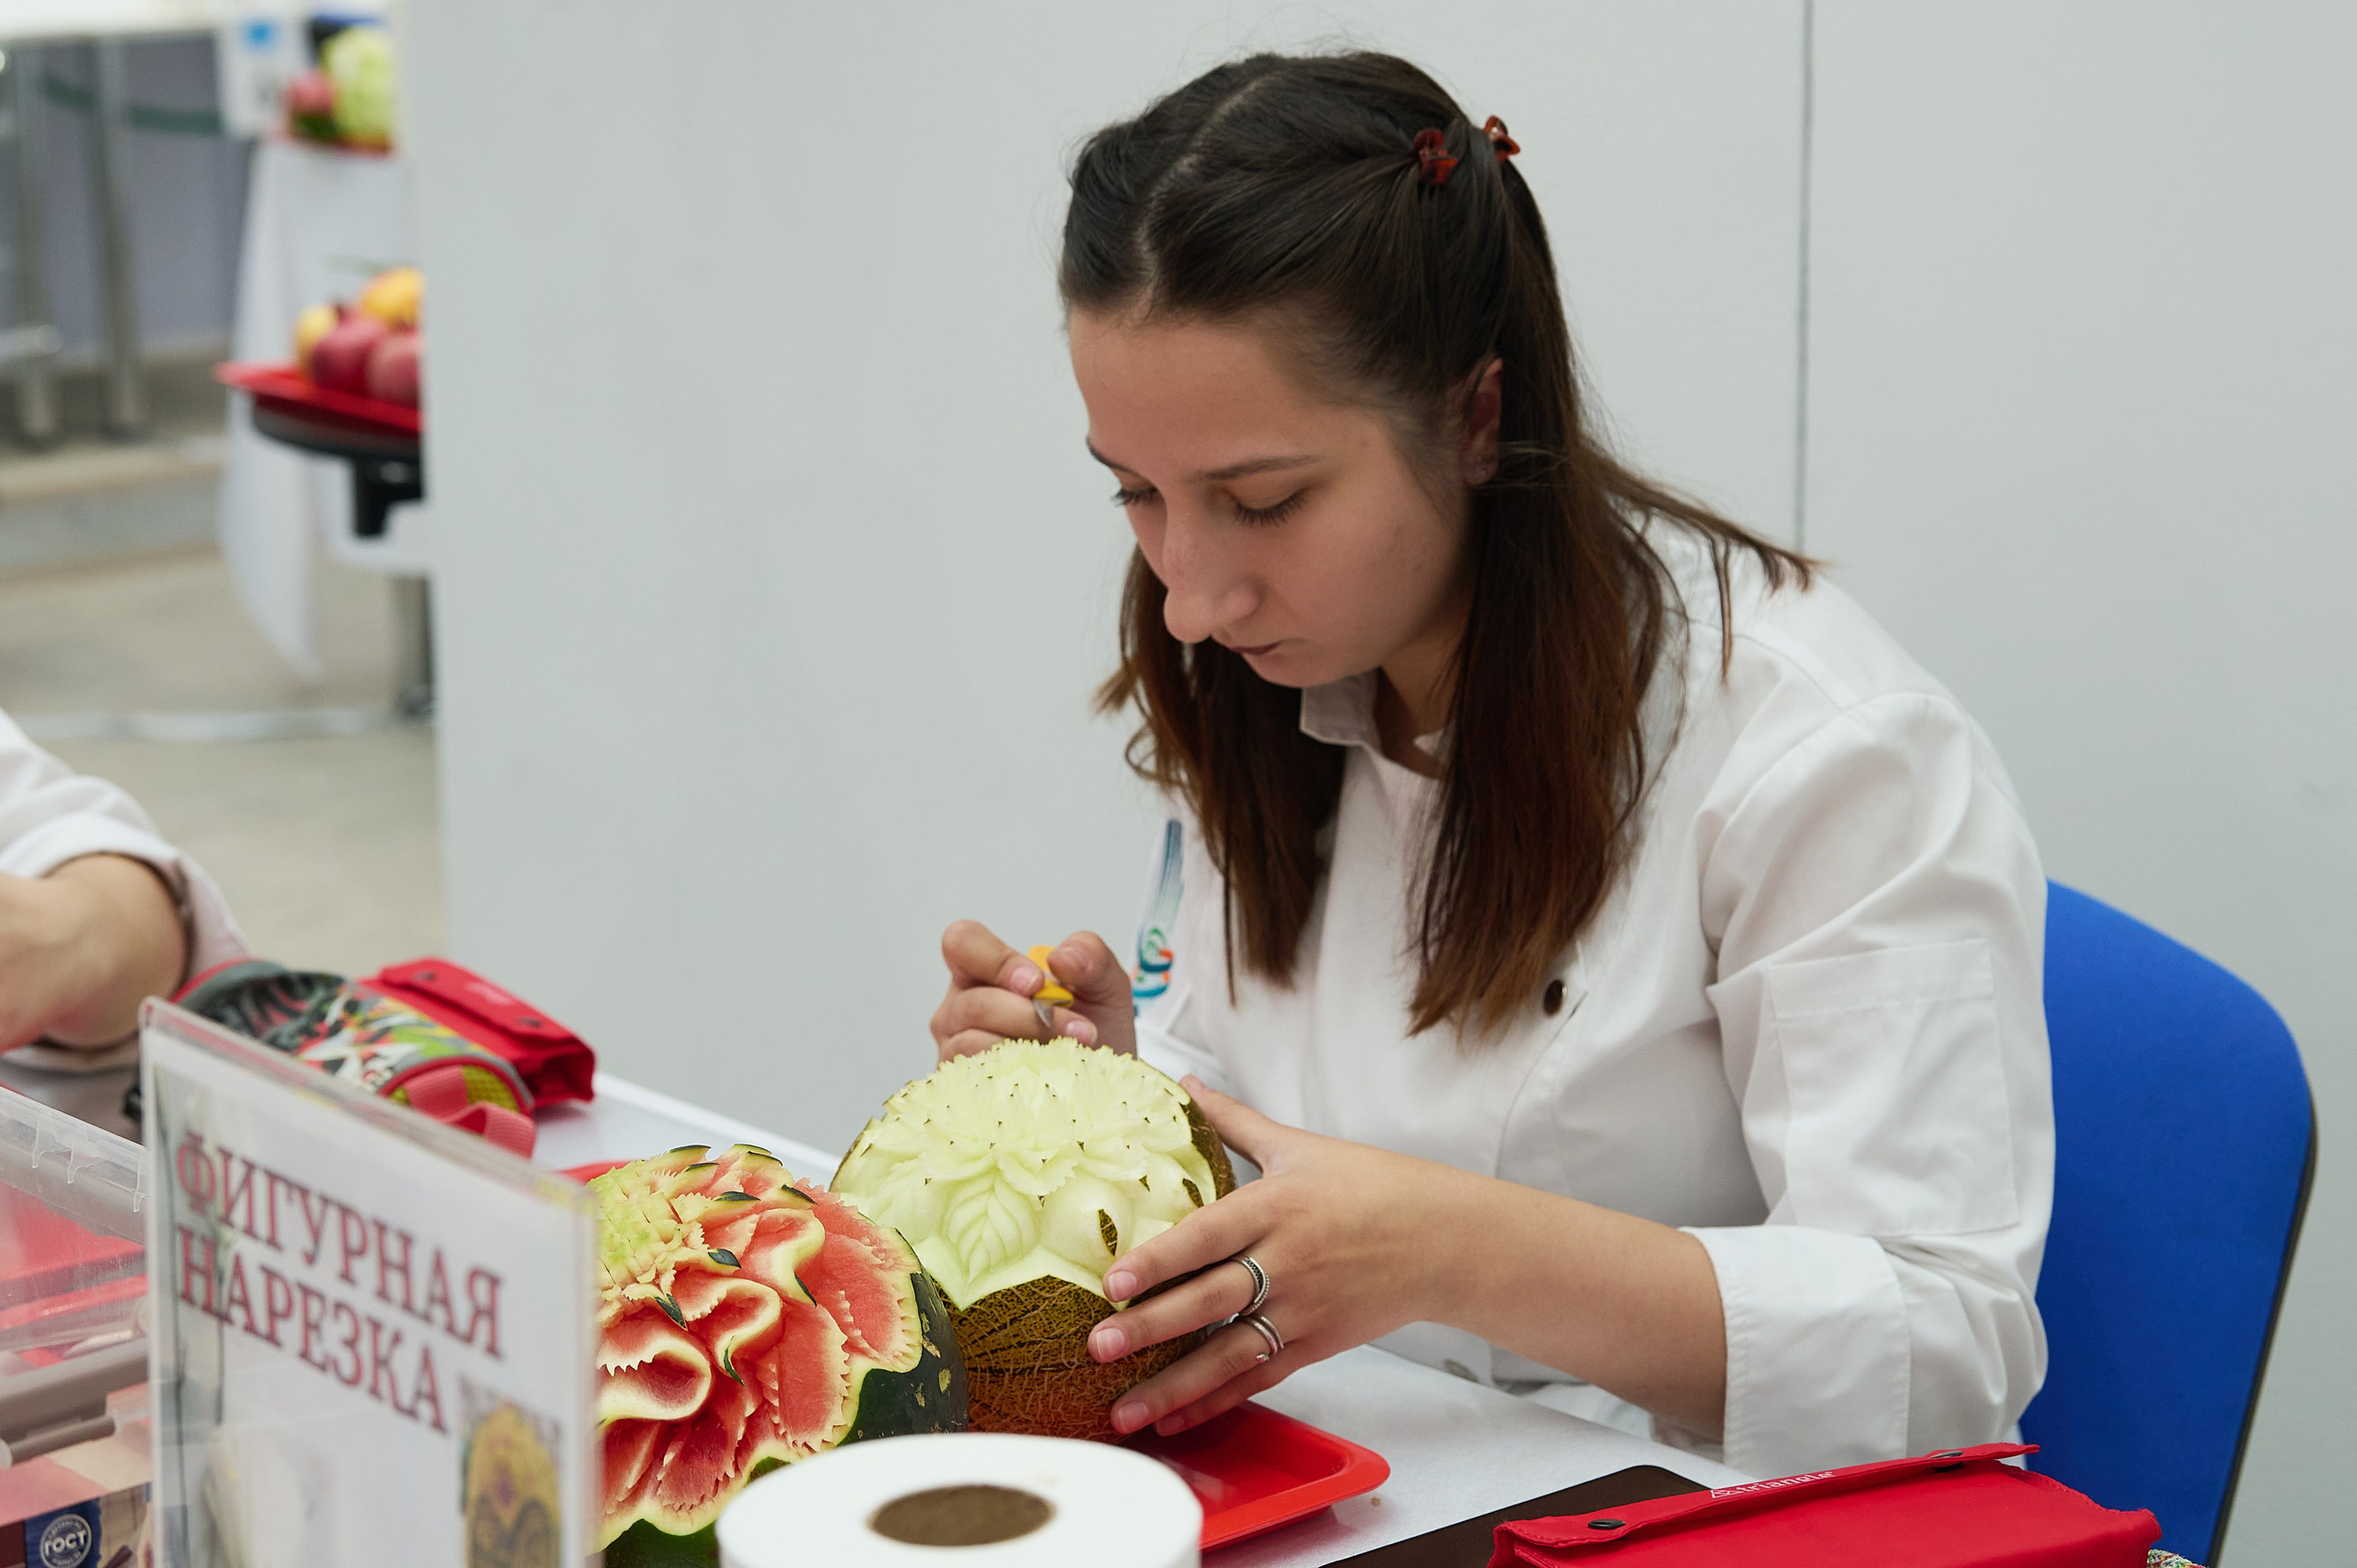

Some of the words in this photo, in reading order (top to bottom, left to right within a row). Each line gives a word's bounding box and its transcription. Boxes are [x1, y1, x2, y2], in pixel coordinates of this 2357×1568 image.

[175, 1224, 449, 1434] НАРЕЗКА
[176, 1132, 504, 1358] ФИГУРНАЯ
[44, 1529, 87, 1556] ГОСТ
